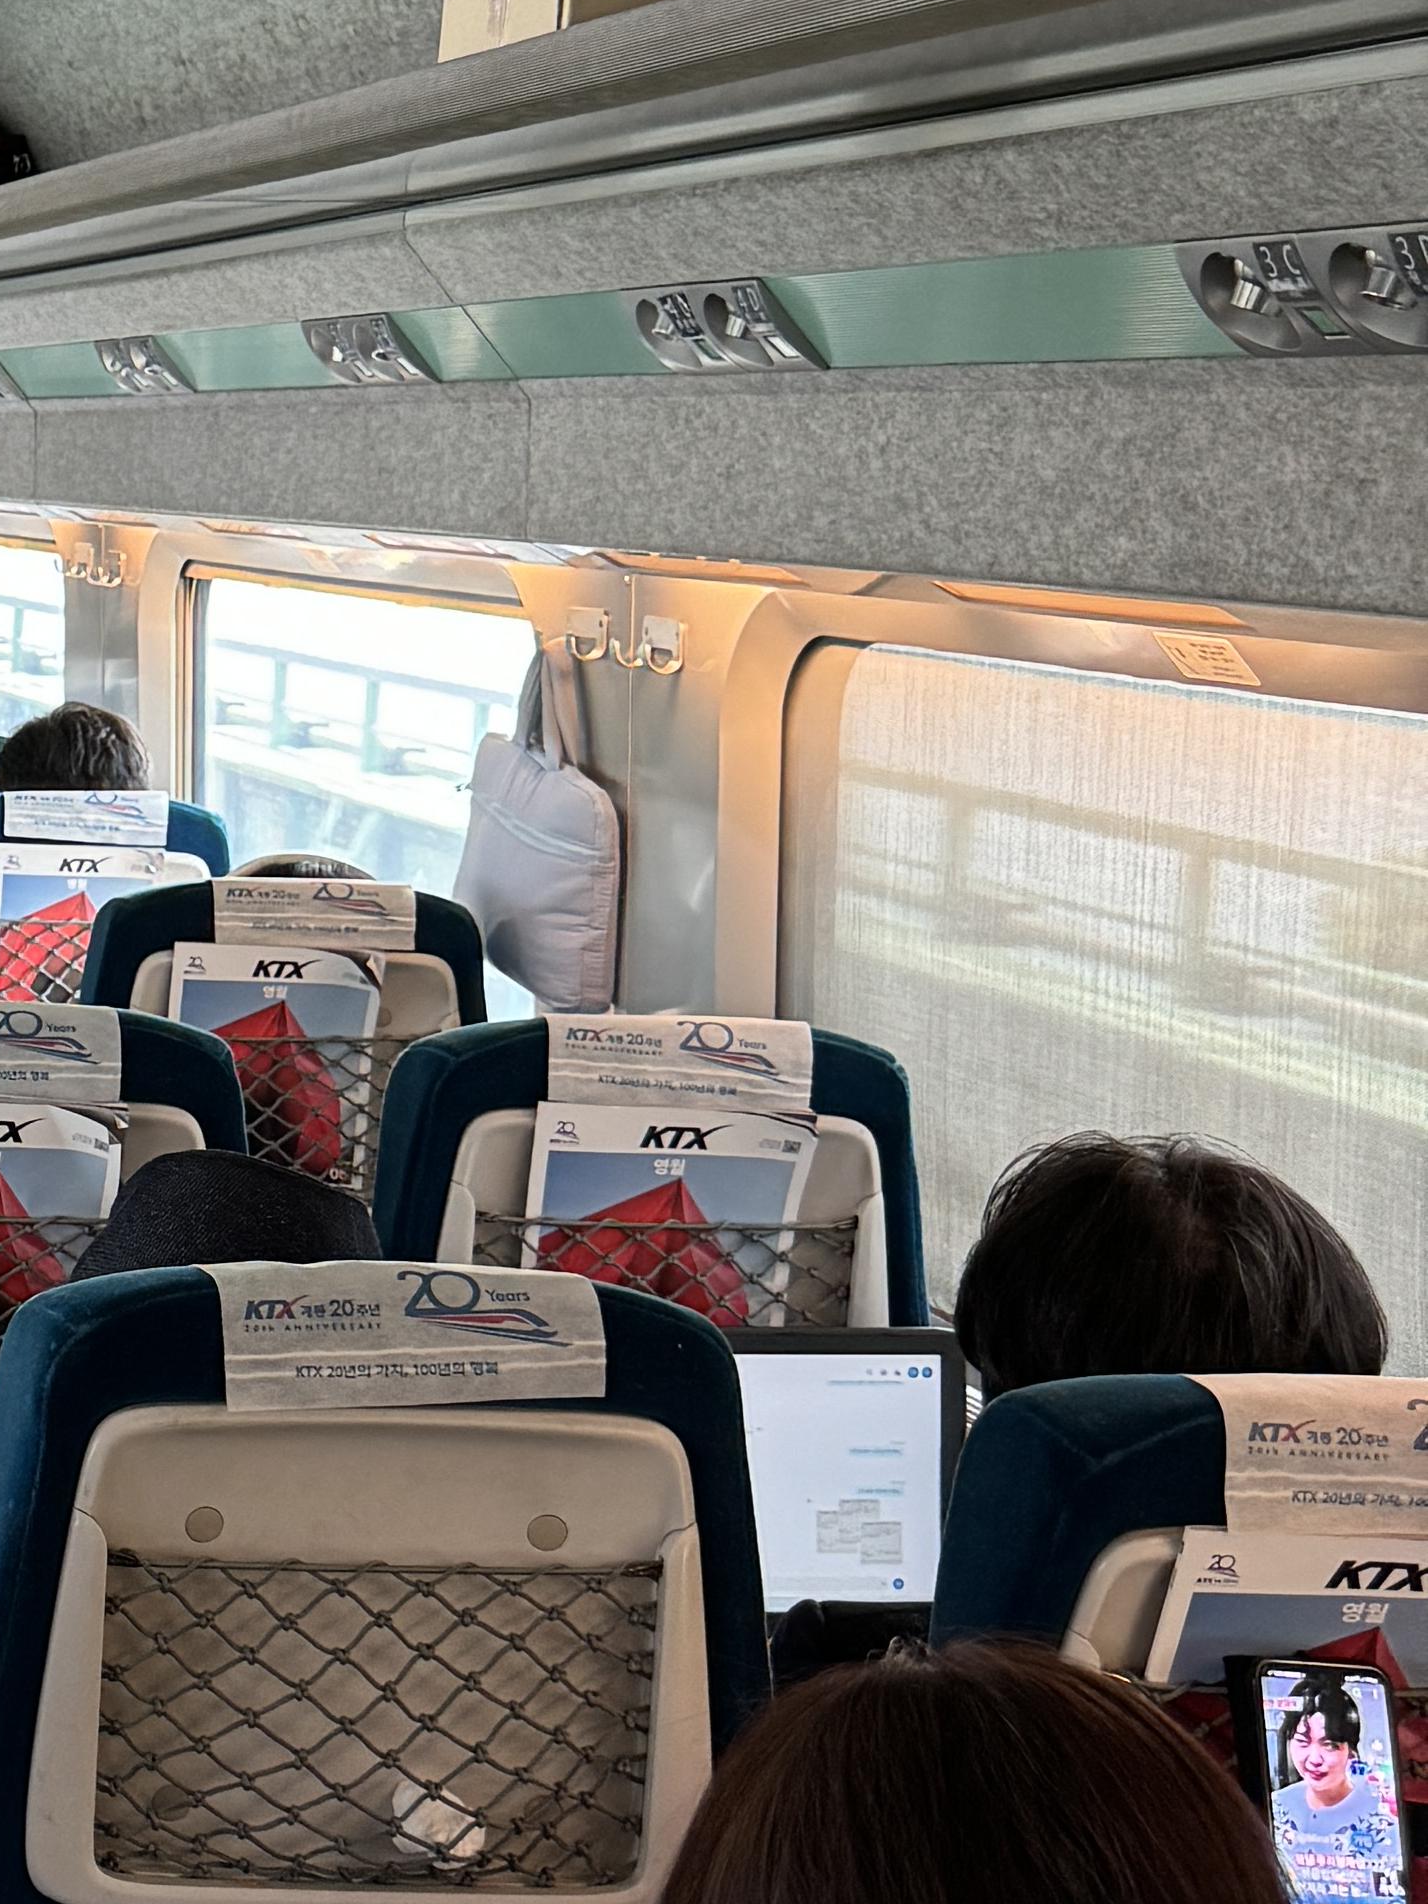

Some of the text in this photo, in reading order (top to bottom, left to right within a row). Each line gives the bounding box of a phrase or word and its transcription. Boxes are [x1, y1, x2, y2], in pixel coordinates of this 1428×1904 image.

[58, 856, 114, 873] KTX
[252, 959, 324, 980] KTX
[45, 1022, 78, 1035] Years
[565, 1026, 614, 1044] KTX
[677, 1020, 769, 1054] 20 Years
[639, 1123, 735, 1151] KTX
[652, 1157, 687, 1177] 영월
[396, 1269, 531, 1316] 20 Years
[245, 1294, 382, 1321] KTX 20주년
[296, 1364, 323, 1379] KTX
[327, 1364, 372, 1380] 20년의
[376, 1363, 409, 1380] 가치,
[412, 1362, 467, 1379] 100년의
[1248, 1419, 1389, 1448] KTX 20주년
[1291, 1490, 1318, 1505] KTX
[1326, 1560, 1428, 1592] KTX
[1341, 1602, 1390, 1625] 영월
